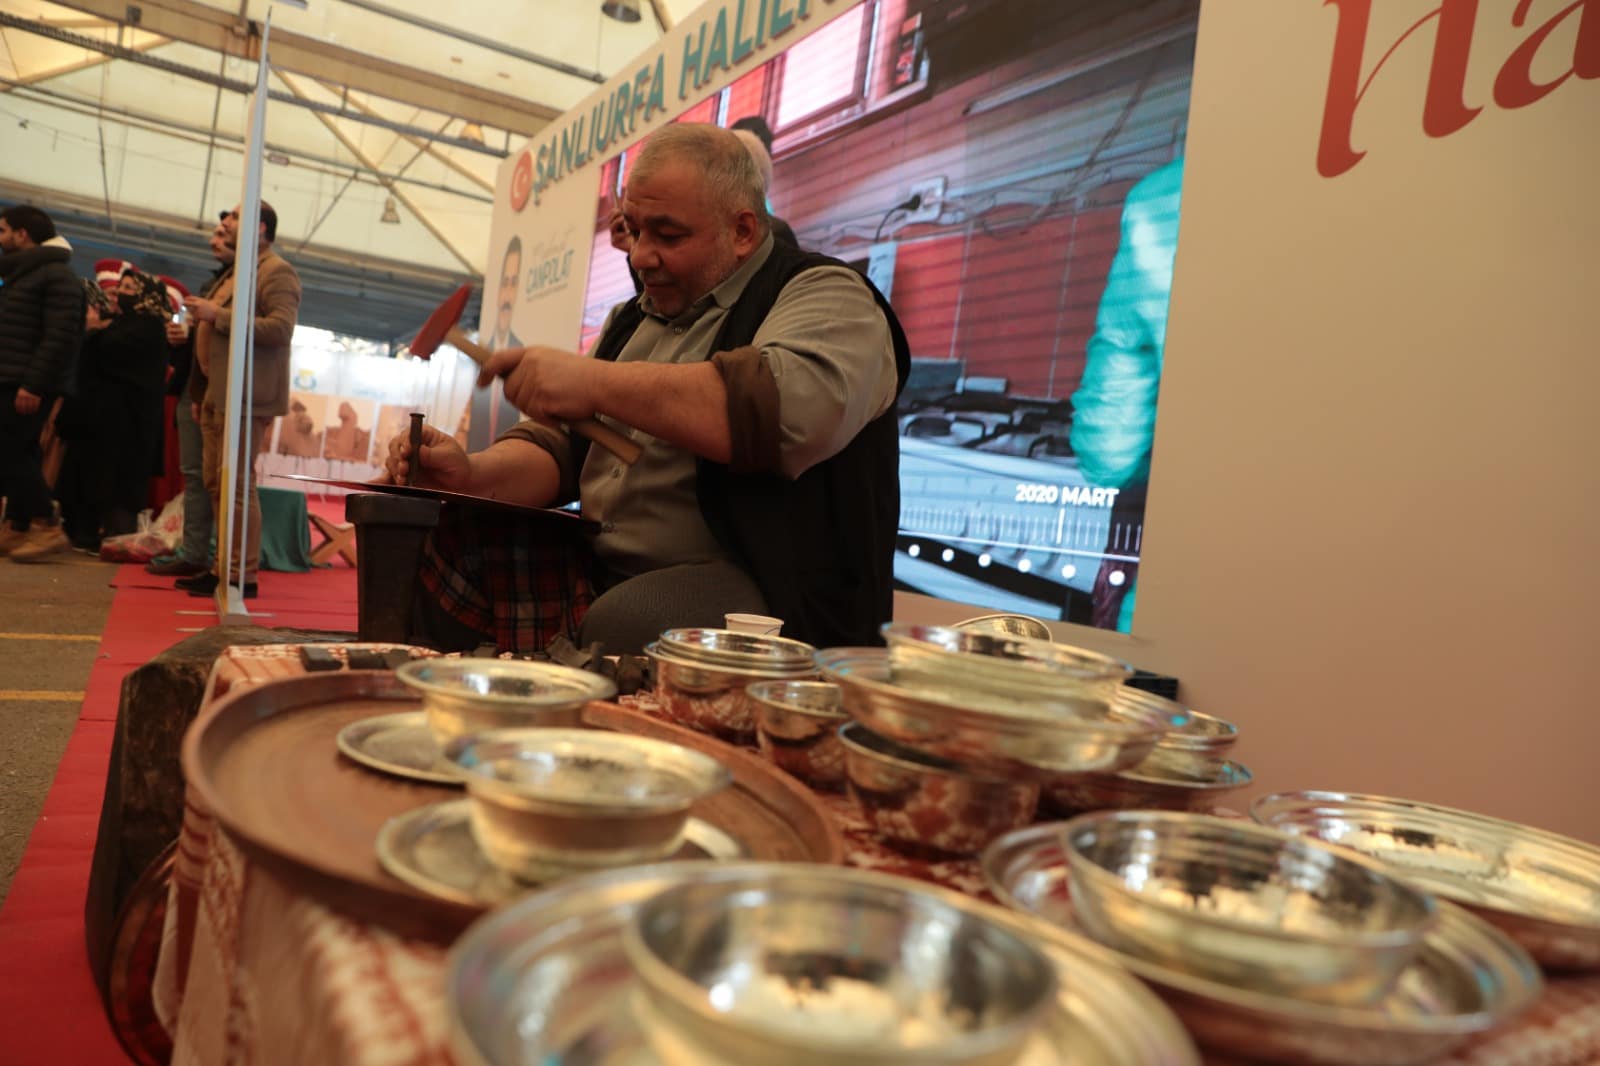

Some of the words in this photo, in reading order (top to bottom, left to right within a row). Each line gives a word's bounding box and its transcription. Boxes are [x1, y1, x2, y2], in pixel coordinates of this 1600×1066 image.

[533, 53, 667, 206] ŞANLIURFA
[1015, 483, 1058, 504] 2020
[1061, 485, 1120, 508] MART
